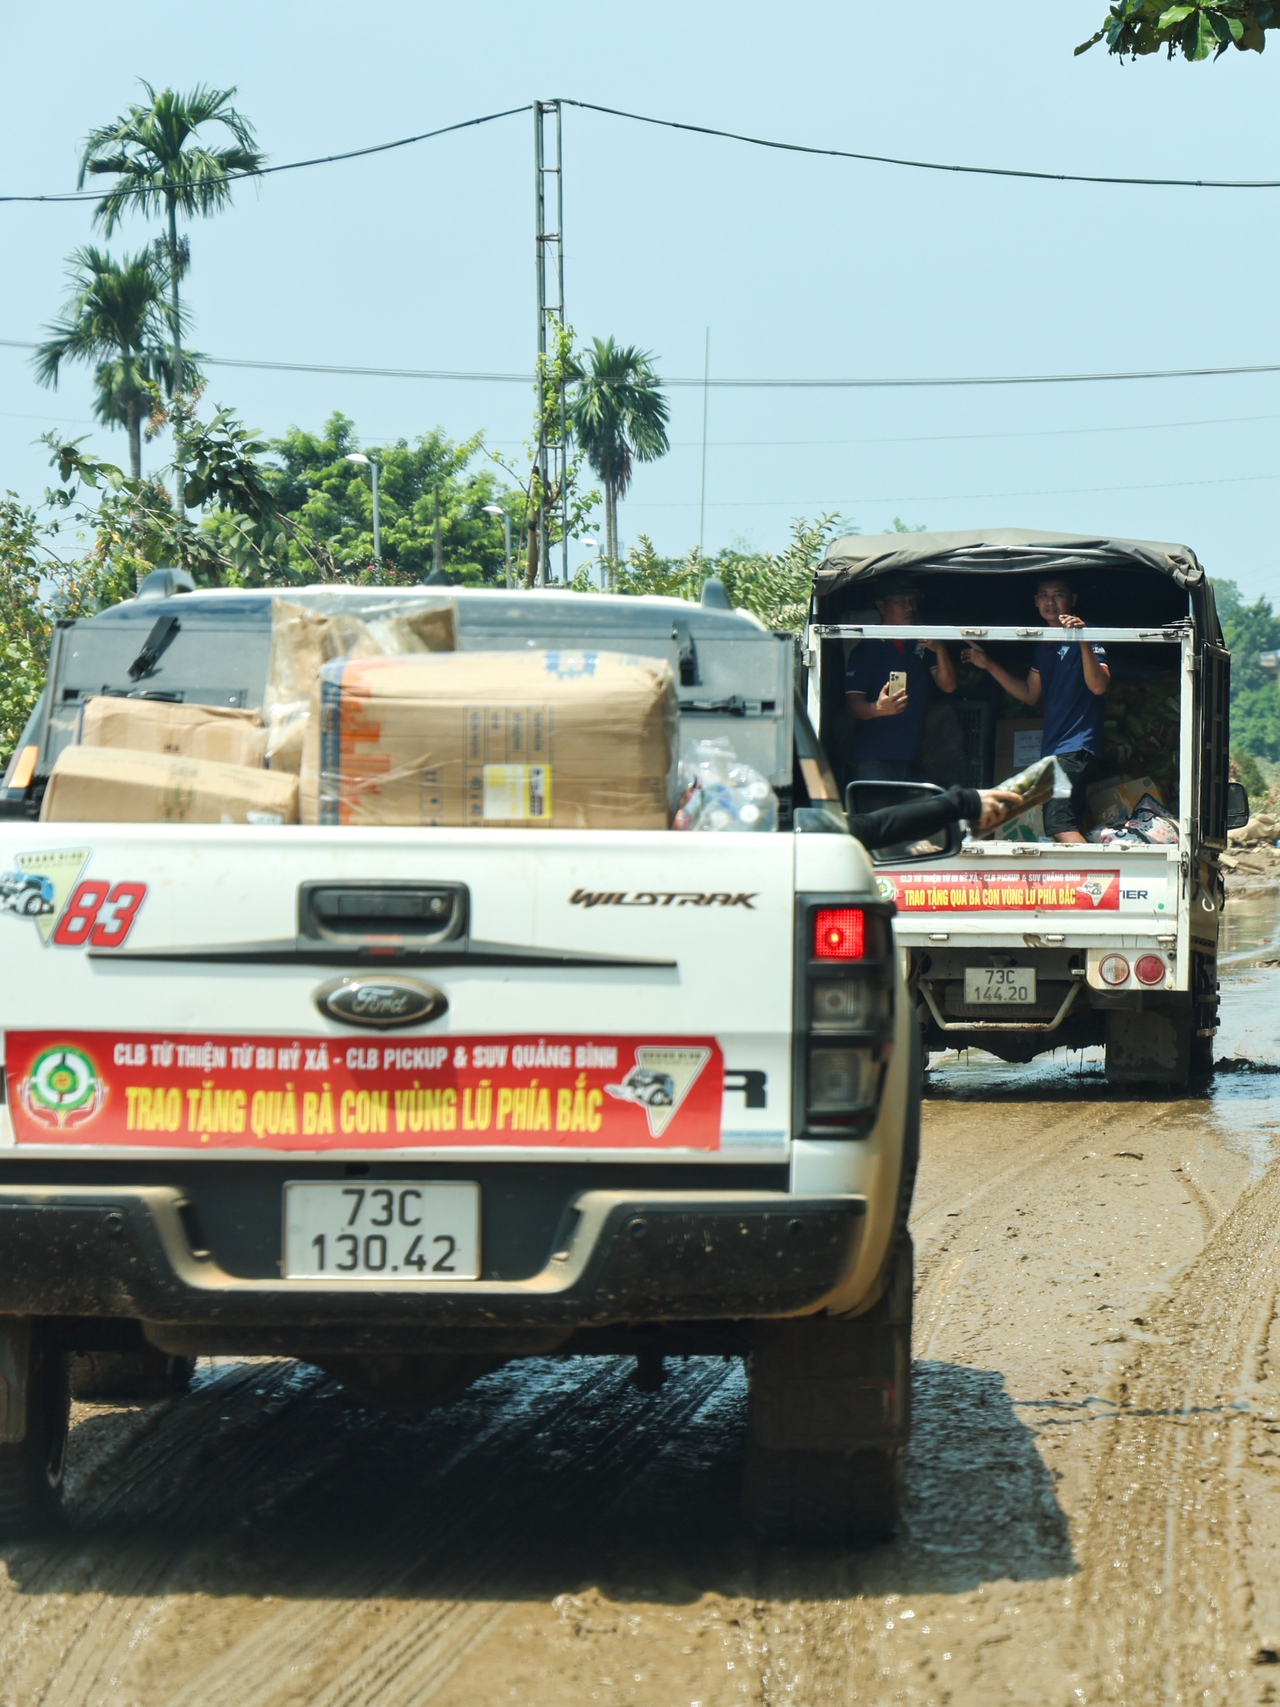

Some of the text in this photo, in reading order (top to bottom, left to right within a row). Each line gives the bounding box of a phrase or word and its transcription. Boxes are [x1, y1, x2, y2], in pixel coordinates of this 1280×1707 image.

[568, 888, 761, 909] WILDTRAK
[904, 889, 925, 906] TRAO
[927, 886, 948, 909] TẶNG
[982, 888, 1000, 905] CON
[1001, 885, 1024, 905] VÙNG
[1037, 885, 1057, 905] PHÍA
[1119, 890, 1148, 899] IER
[53, 881, 147, 947] 83
[985, 970, 1015, 985] 73C
[351, 987, 408, 1013] Ford
[974, 986, 1028, 1001] 144.20
[113, 1044, 147, 1067] CLB
[257, 1048, 275, 1070] BI
[345, 1048, 380, 1069] CLB
[383, 1048, 448, 1070] PICKUP
[453, 1048, 468, 1069] &
[472, 1049, 509, 1069] SUV
[576, 1044, 618, 1069] BÌNH
[125, 1086, 182, 1132] TRAO
[187, 1080, 247, 1142] TẶNG
[250, 1083, 298, 1139] QUÀ
[340, 1089, 389, 1133] CON
[394, 1080, 458, 1133] VÙNG
[463, 1078, 492, 1131] LŨ
[497, 1079, 552, 1132] PHÍA
[557, 1073, 603, 1132] BẮC
[341, 1189, 422, 1227] 73C
[312, 1234, 456, 1272] 130.42
